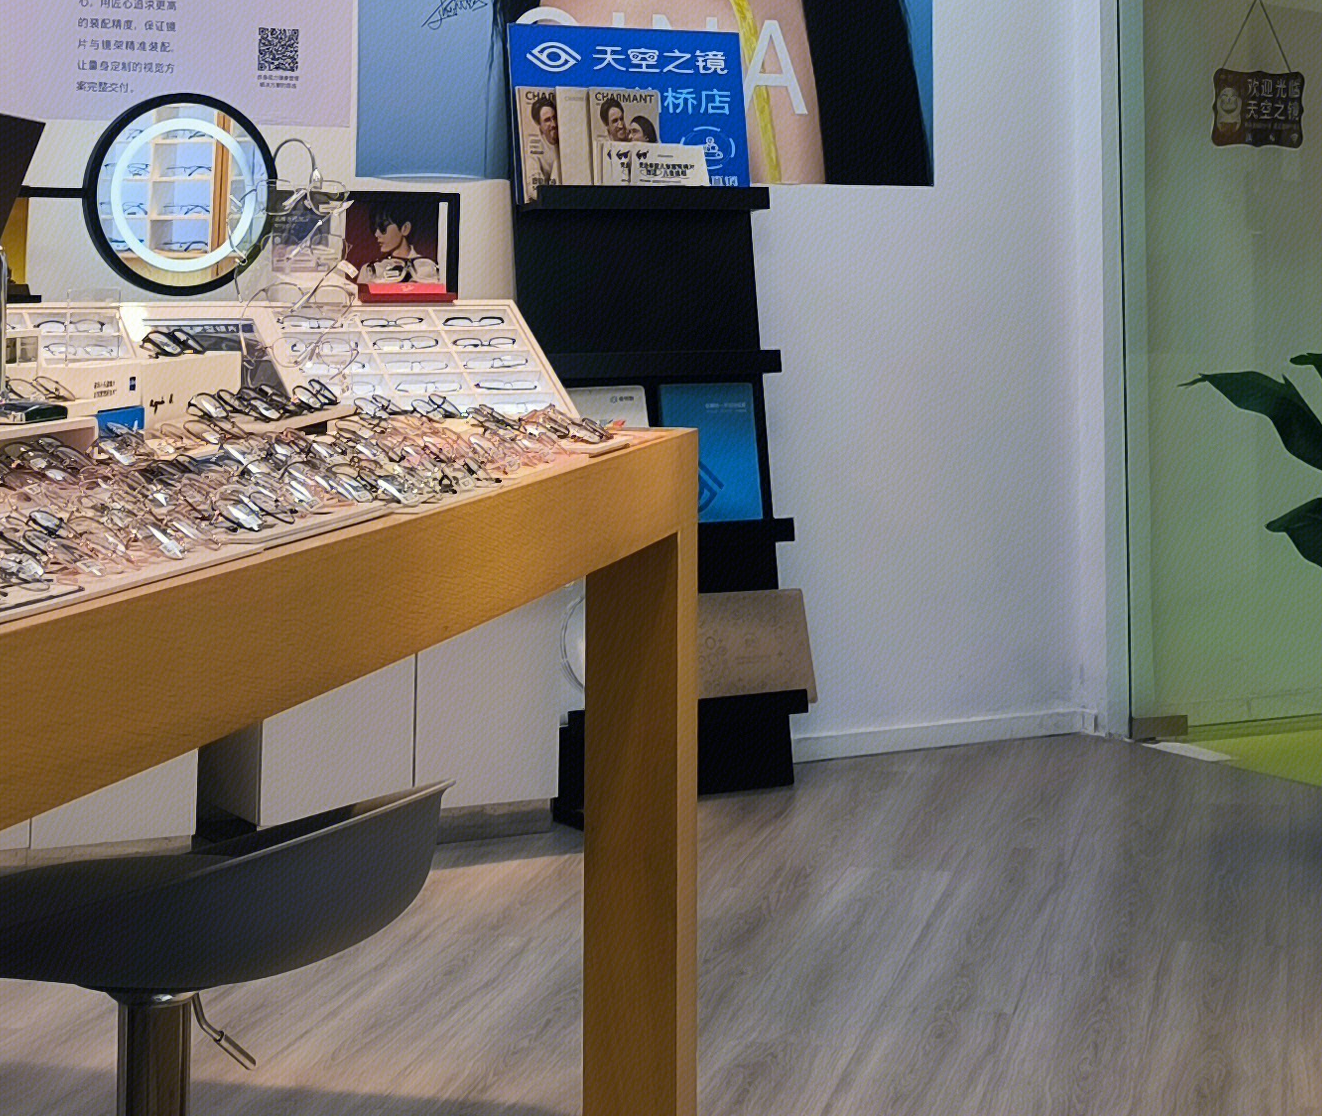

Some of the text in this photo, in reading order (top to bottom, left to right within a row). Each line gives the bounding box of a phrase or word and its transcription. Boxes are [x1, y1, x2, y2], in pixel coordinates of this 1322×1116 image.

[592, 45, 729, 75] 天空之镜
[634, 86, 731, 115] 桥店
[1247, 78, 1301, 98] 欢迎光临
[1246, 99, 1300, 121] 天空之镜
